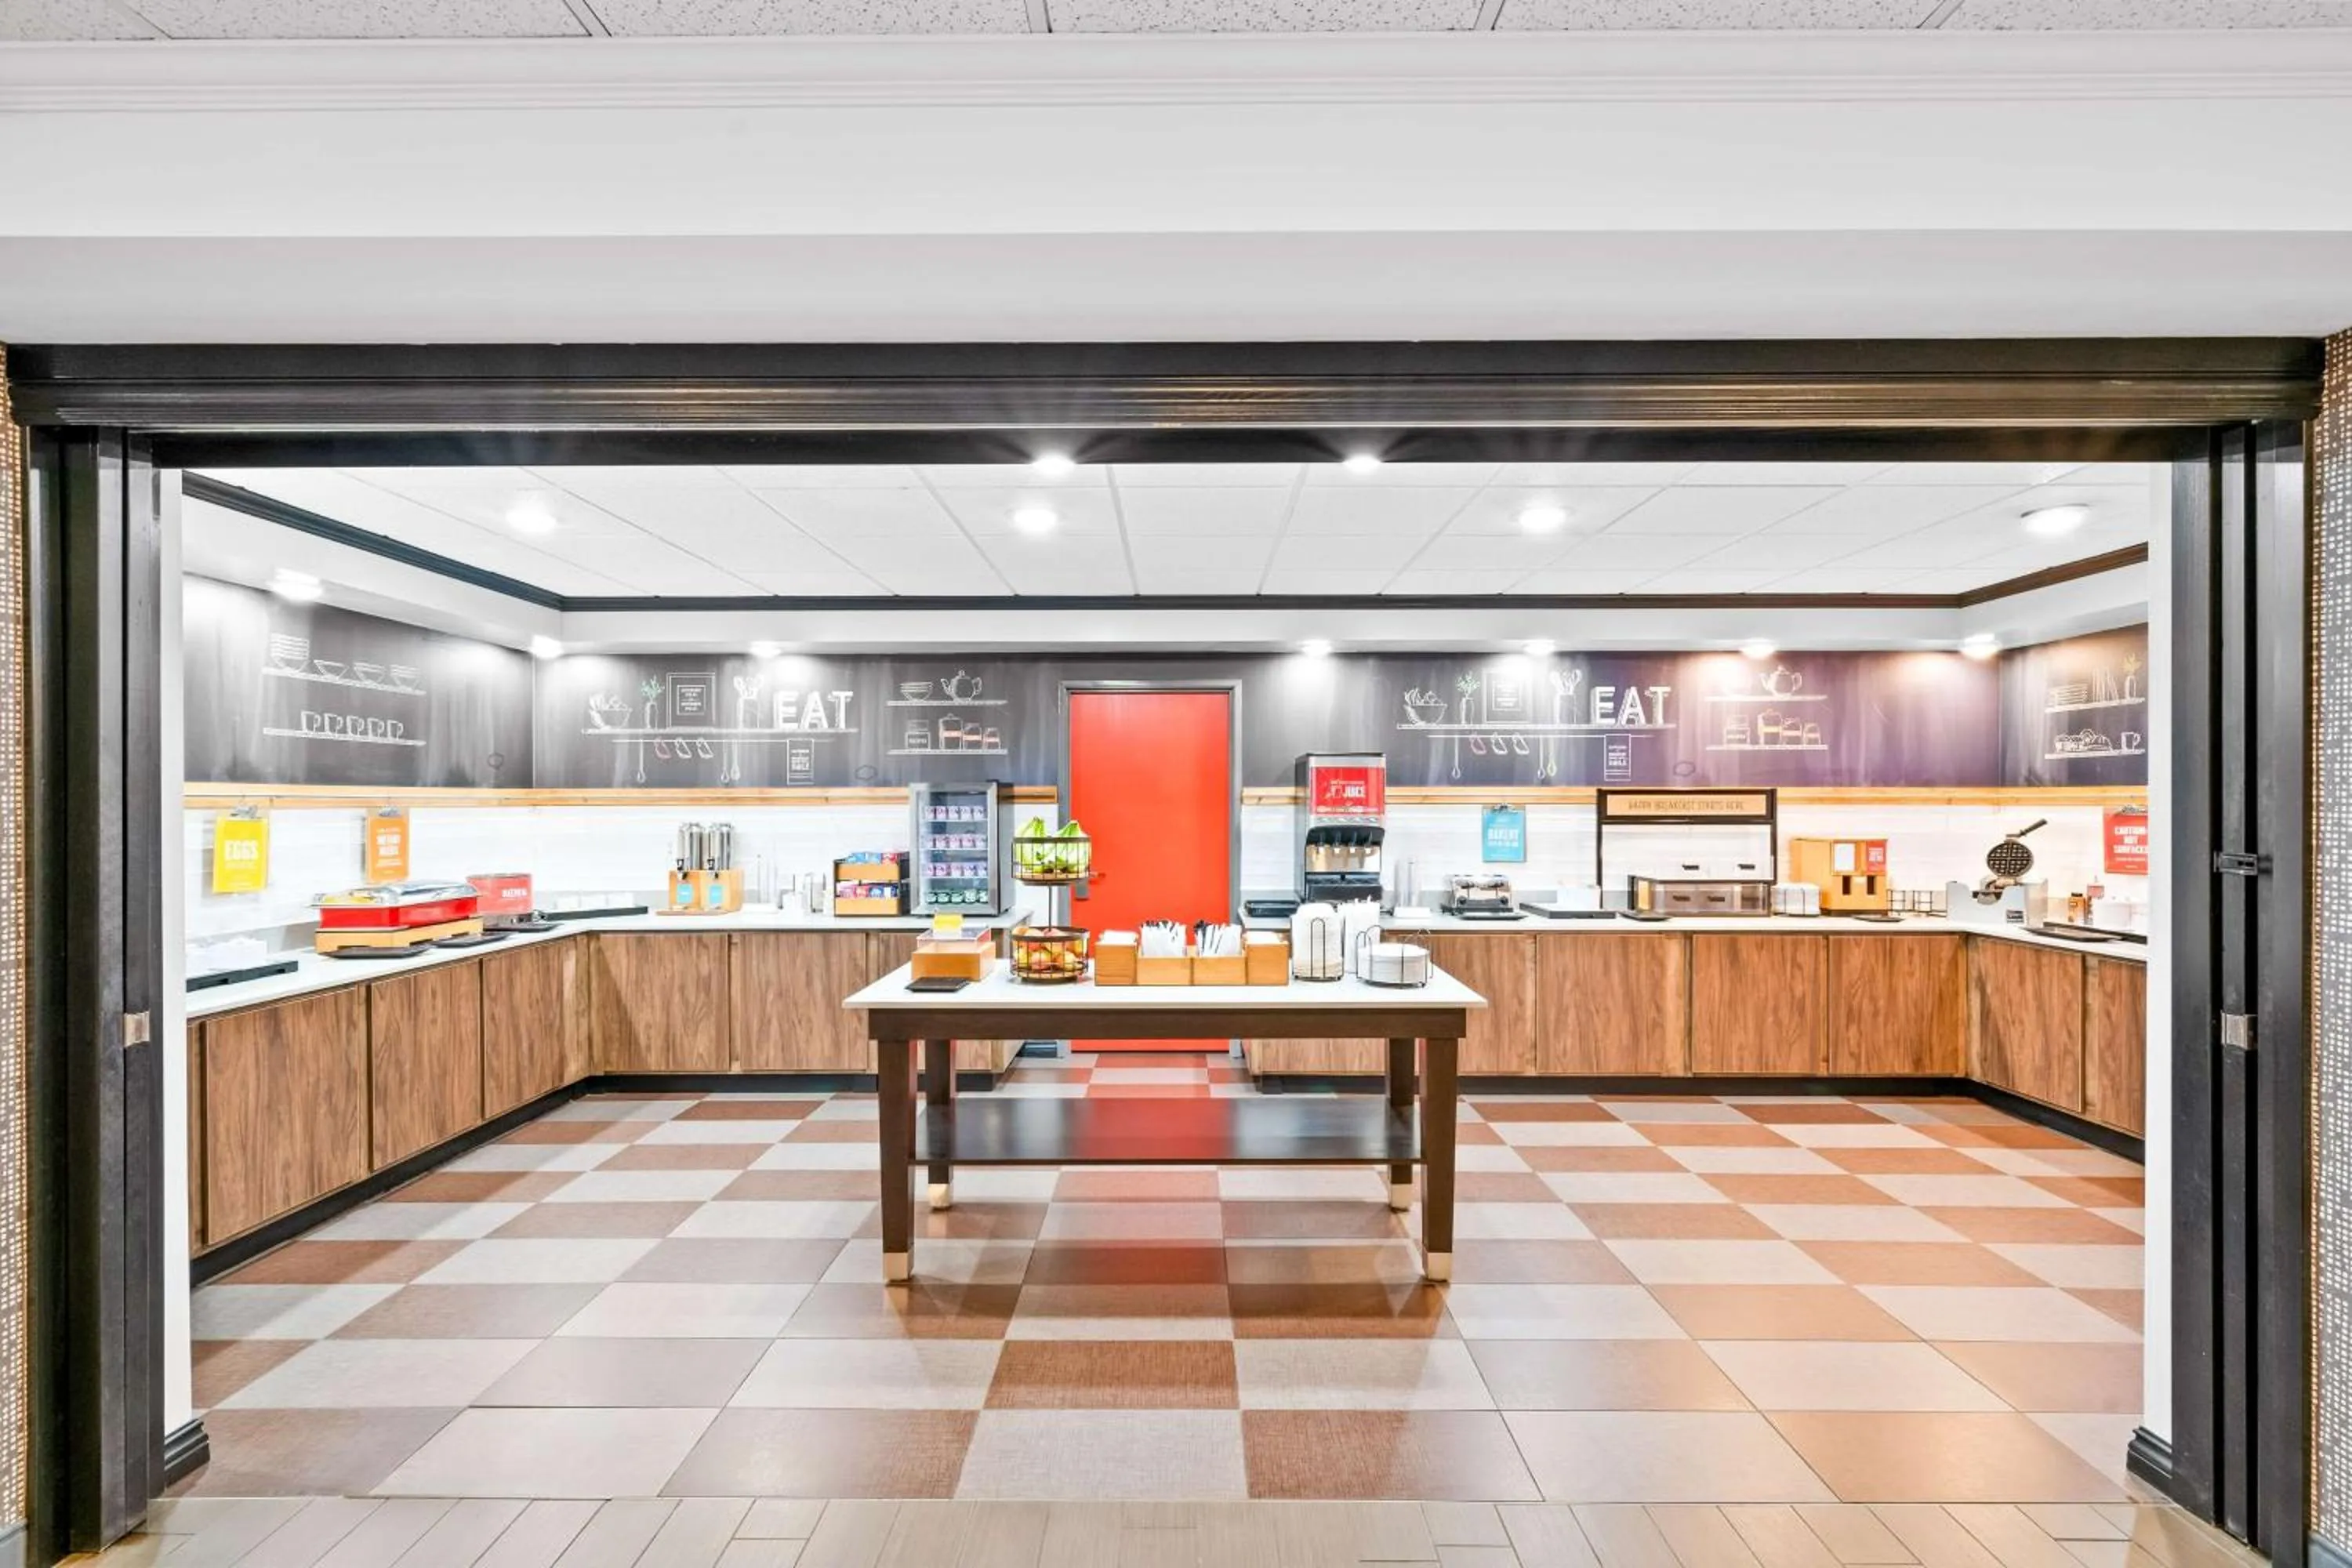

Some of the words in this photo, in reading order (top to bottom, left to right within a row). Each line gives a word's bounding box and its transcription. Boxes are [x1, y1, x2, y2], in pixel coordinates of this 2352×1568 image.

[773, 690, 854, 729] EAT
[1590, 686, 1671, 726] EAT
[224, 840, 260, 861] EGGS
